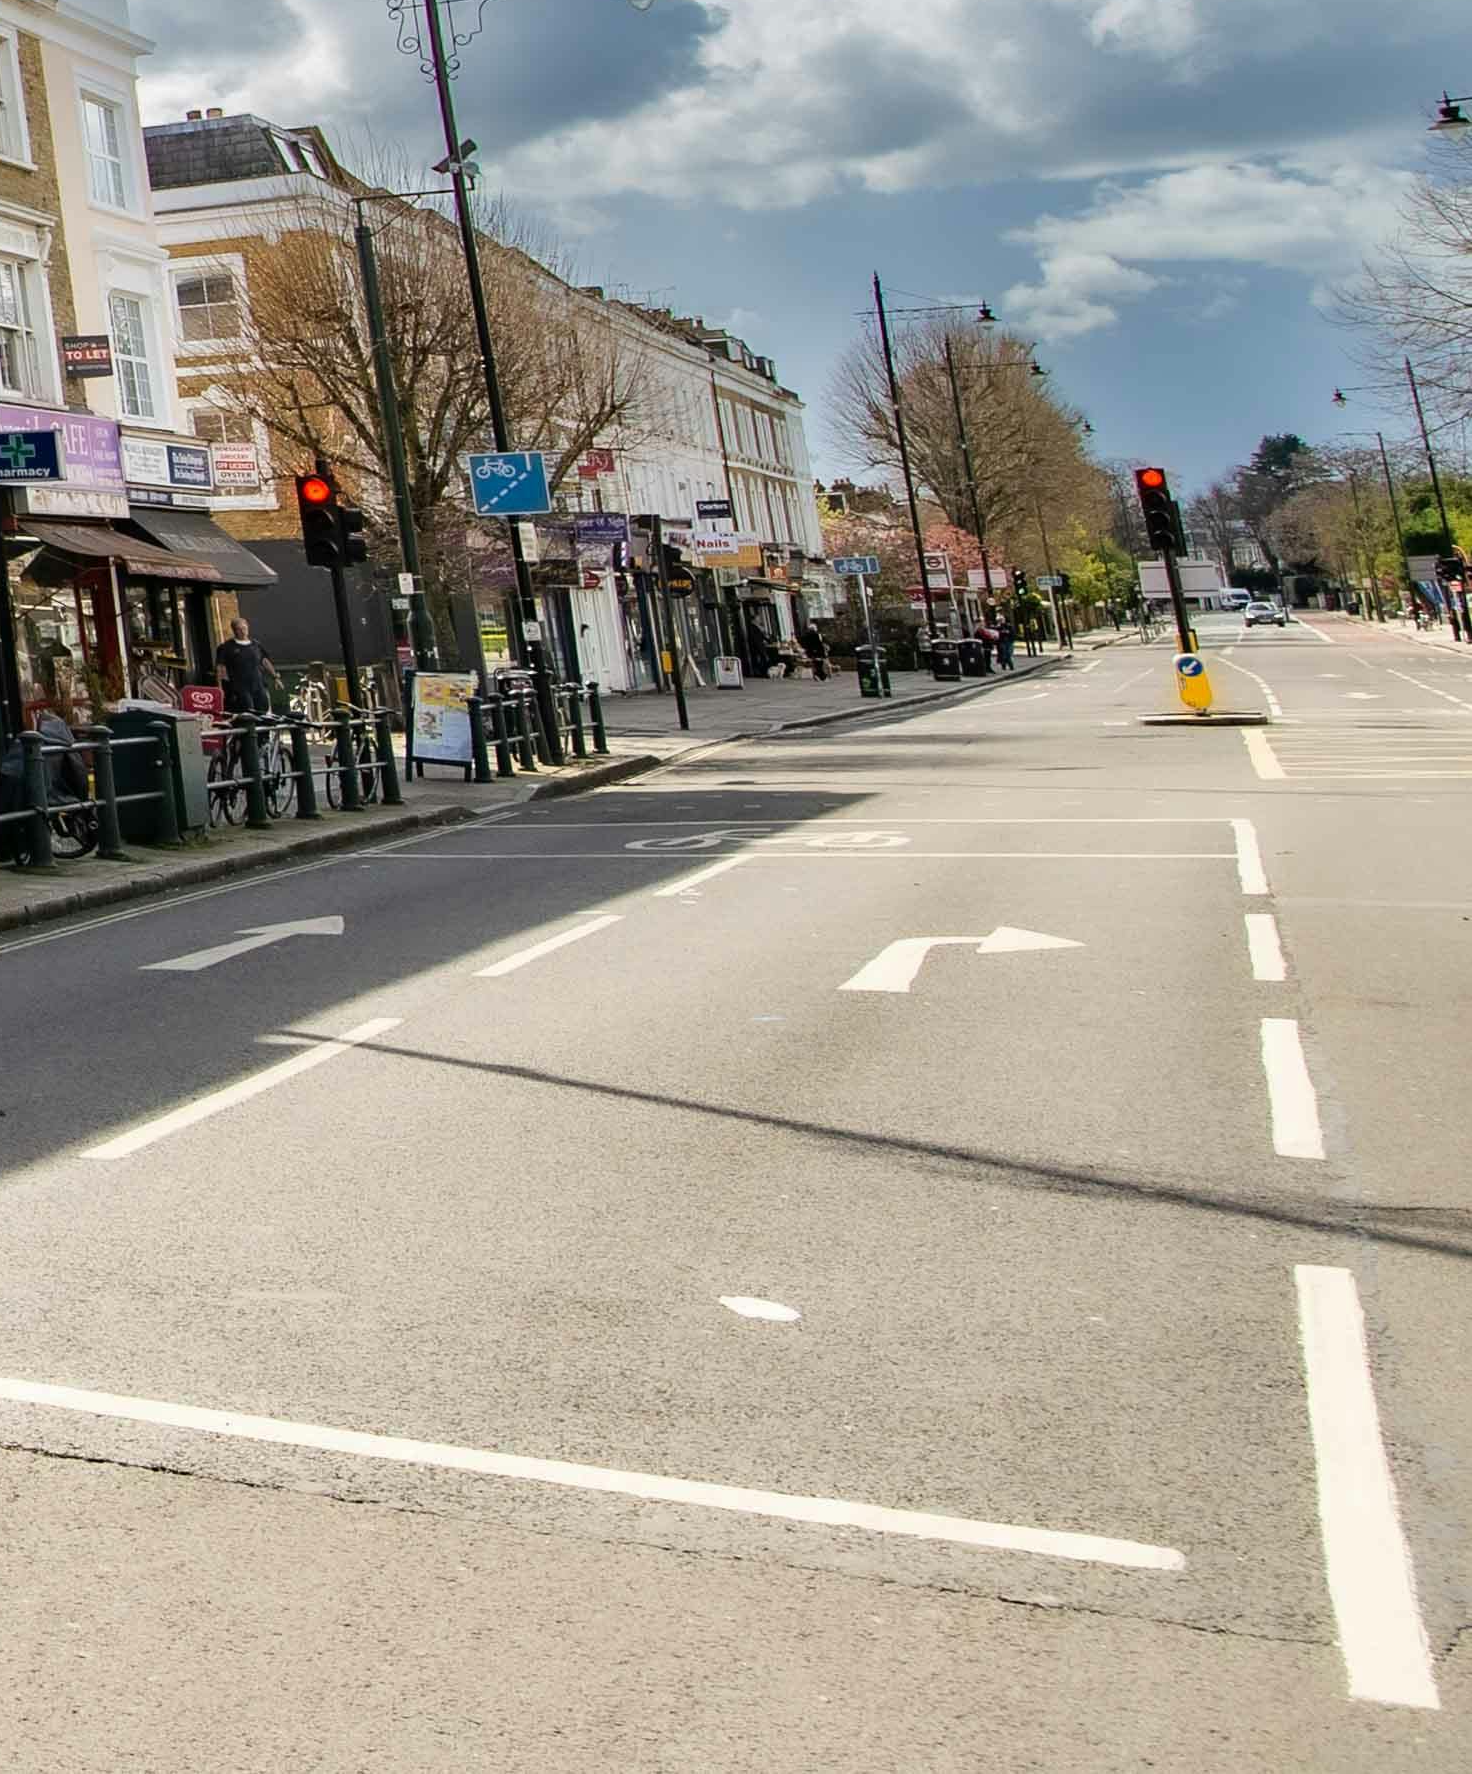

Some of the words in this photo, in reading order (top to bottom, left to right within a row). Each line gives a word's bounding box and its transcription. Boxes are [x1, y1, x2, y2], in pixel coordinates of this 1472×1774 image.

[66, 350, 82, 360] TO
[86, 349, 108, 360] LET
[697, 539, 730, 548] Nails
